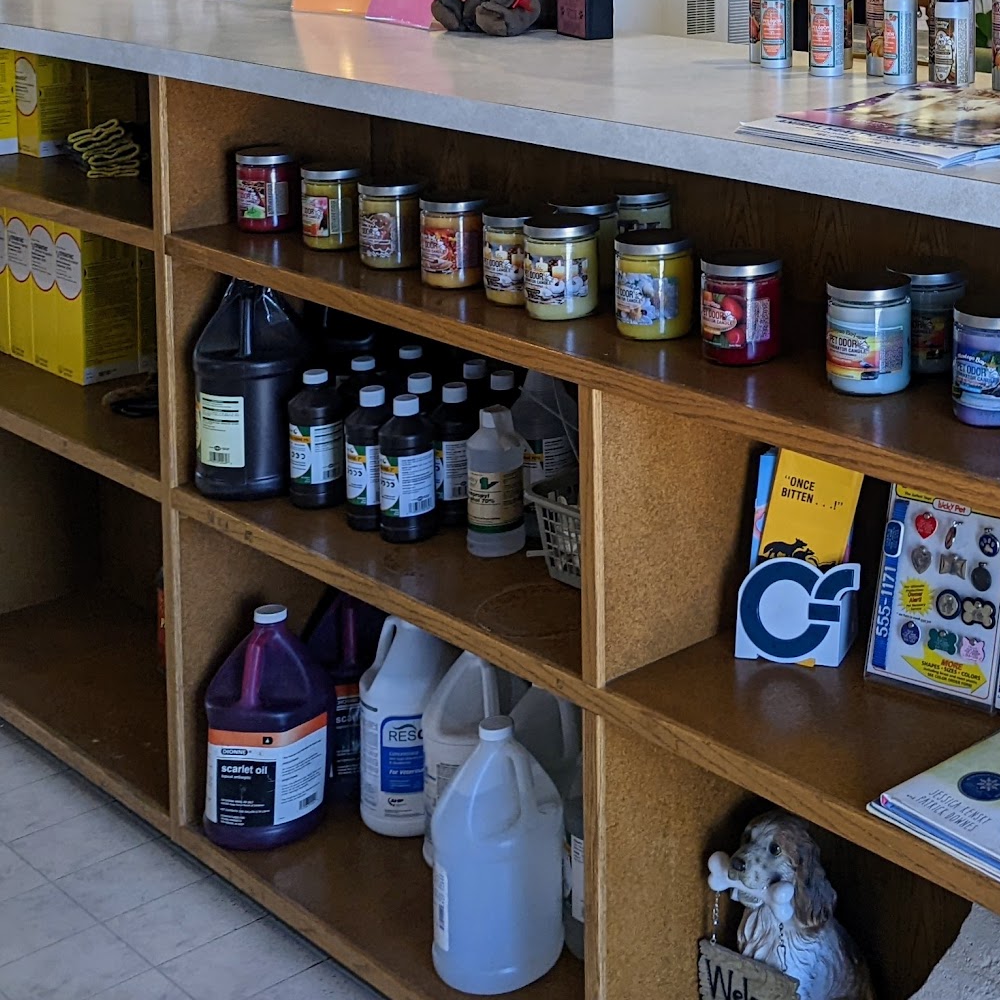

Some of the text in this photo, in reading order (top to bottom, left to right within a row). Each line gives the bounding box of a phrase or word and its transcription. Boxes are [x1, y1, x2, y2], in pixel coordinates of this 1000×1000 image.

[838, 337, 857, 348] ODOR
[966, 365, 987, 377] ODOR
[785, 475, 815, 491] “ONCE
[781, 487, 814, 504] BITTEN
[955, 505, 966, 513] Pet
[875, 566, 896, 638] 555-1171
[921, 660, 940, 670] SHAPES
[943, 667, 957, 675] SIZES
[961, 671, 981, 680] COLORS
[940, 659, 963, 670] MORE
[221, 764, 268, 775] scarlet oil
[928, 789, 960, 810] JESSICA
[915, 795, 948, 818] PATRICK
[948, 811, 979, 833] DOWNES
[704, 959, 761, 1000] Wel
